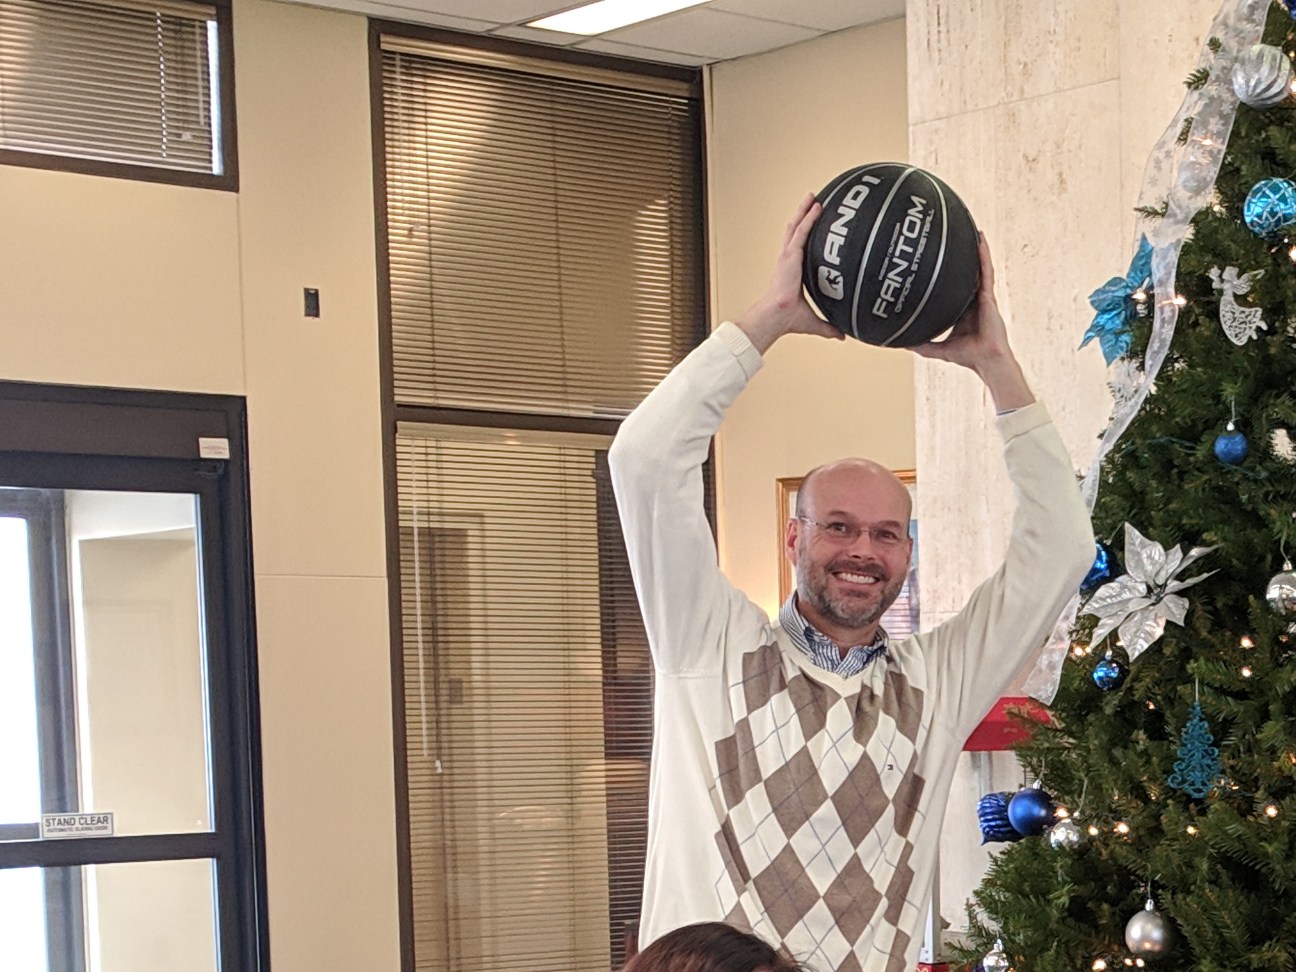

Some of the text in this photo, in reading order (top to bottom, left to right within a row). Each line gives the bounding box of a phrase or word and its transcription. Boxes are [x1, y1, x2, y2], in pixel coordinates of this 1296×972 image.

[872, 195, 927, 318] FANTOM
[45, 815, 109, 827] STAND CLEAR
